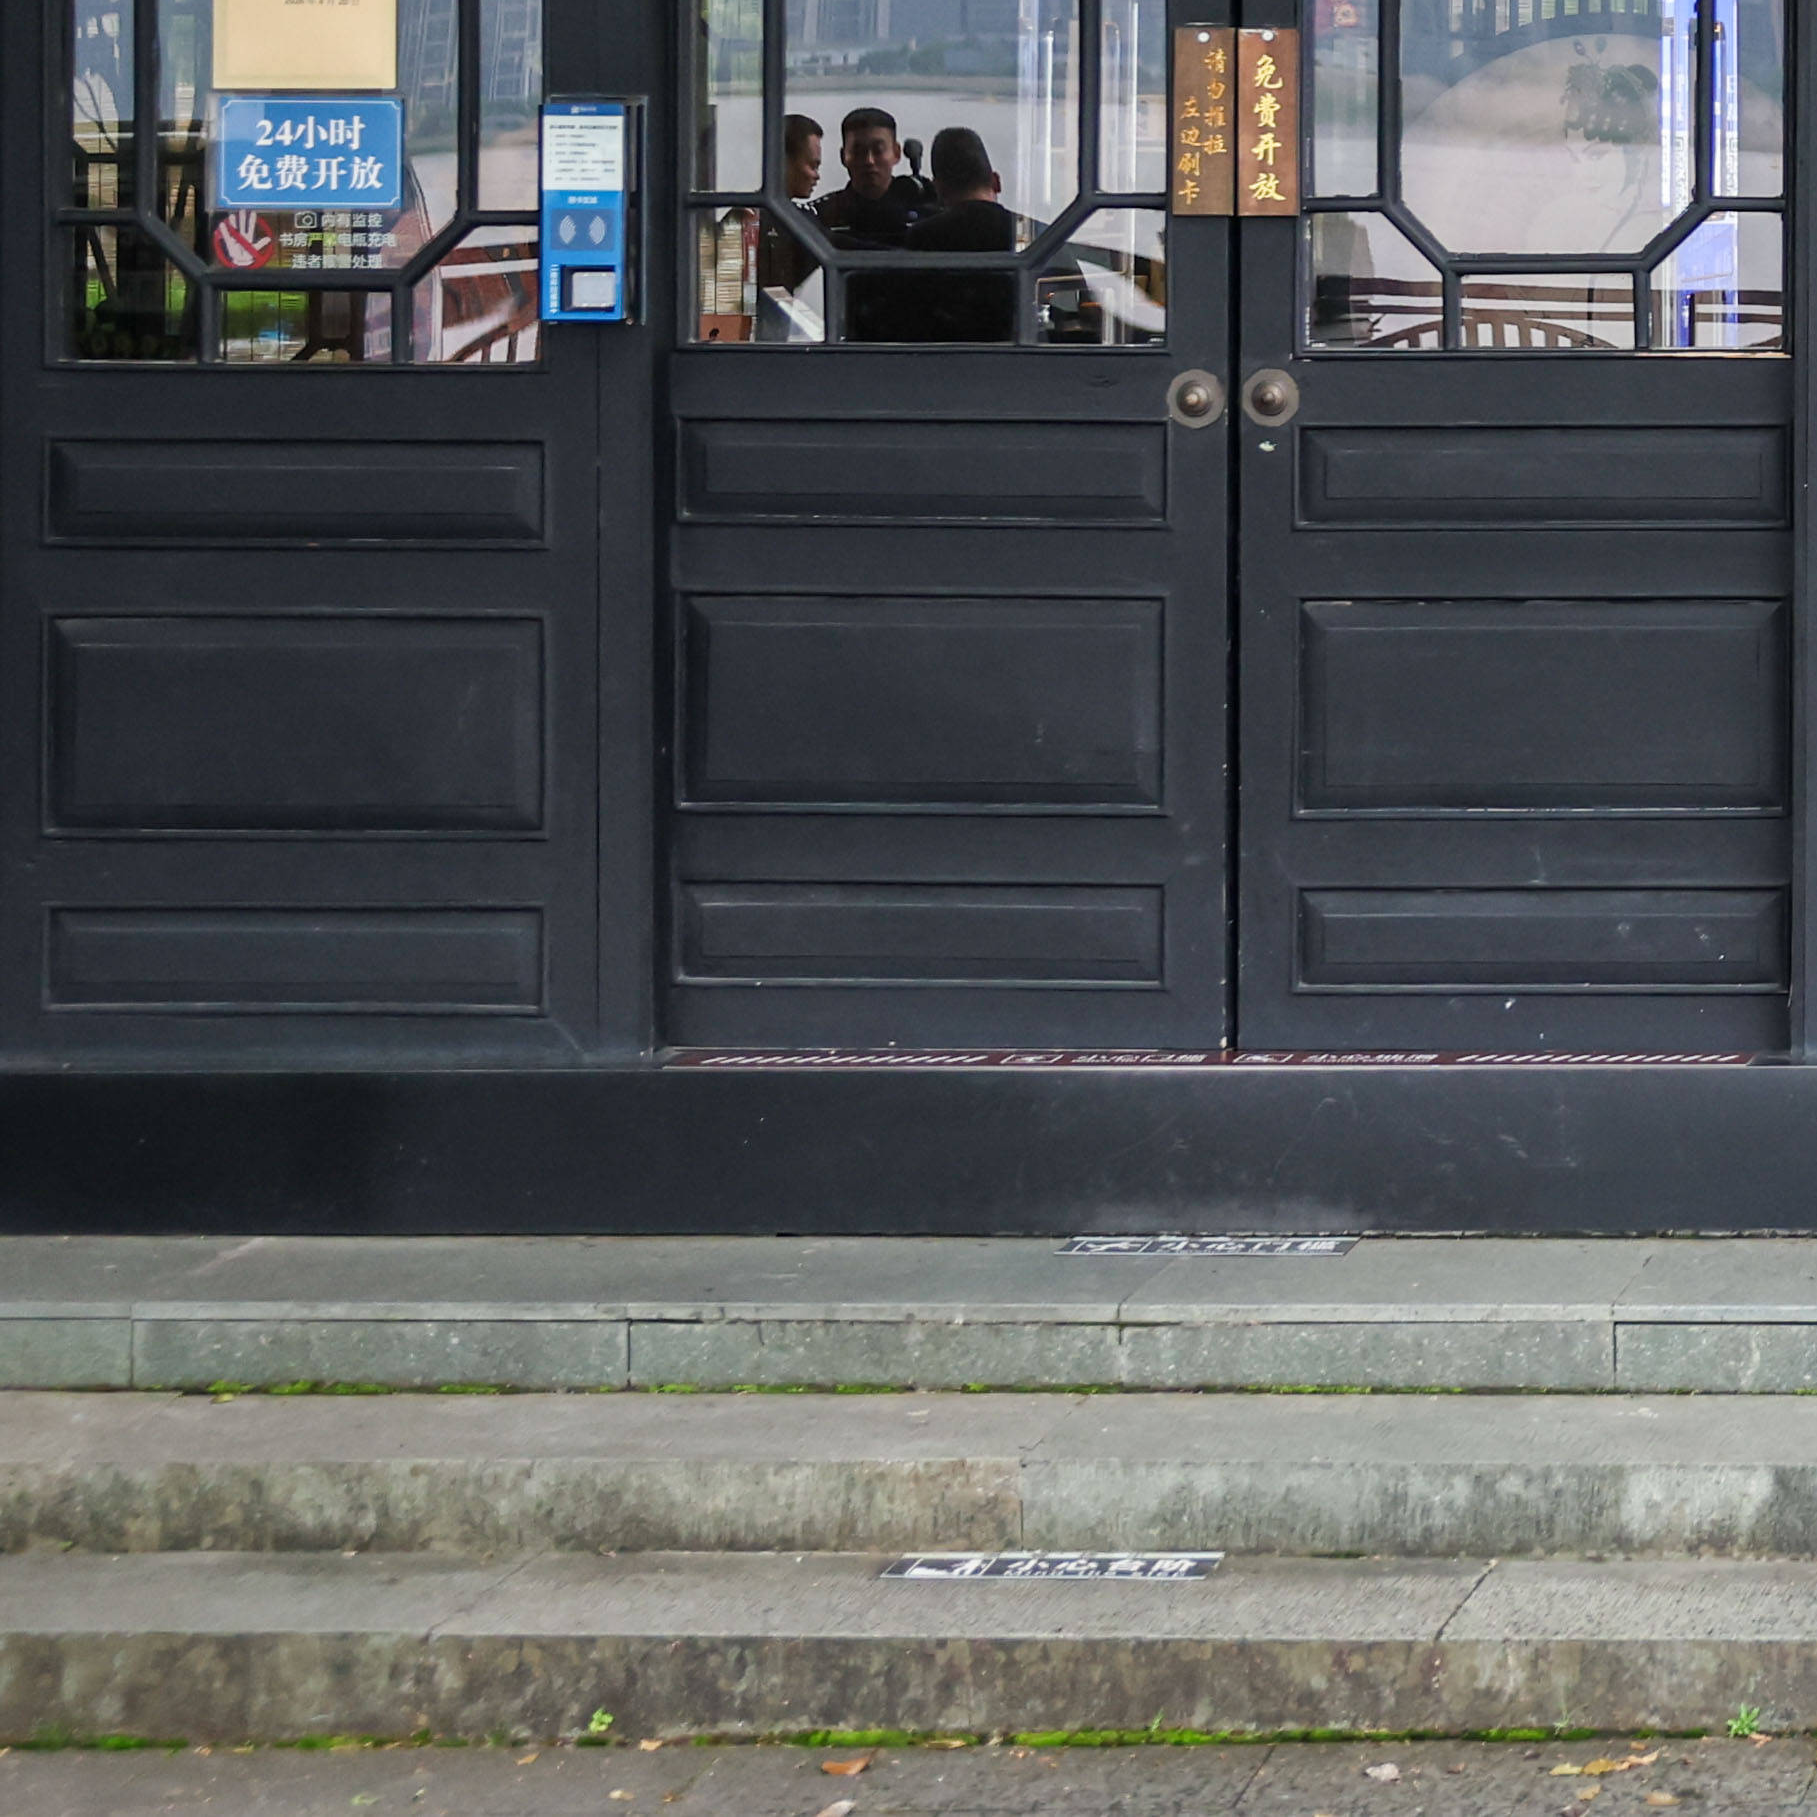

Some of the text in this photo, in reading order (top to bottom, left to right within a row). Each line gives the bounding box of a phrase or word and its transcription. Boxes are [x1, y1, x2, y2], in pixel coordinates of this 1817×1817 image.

[1203, 48, 1228, 155] 请勿推拉
[255, 115, 367, 151] 24小时
[237, 153, 385, 191] 免费开放
